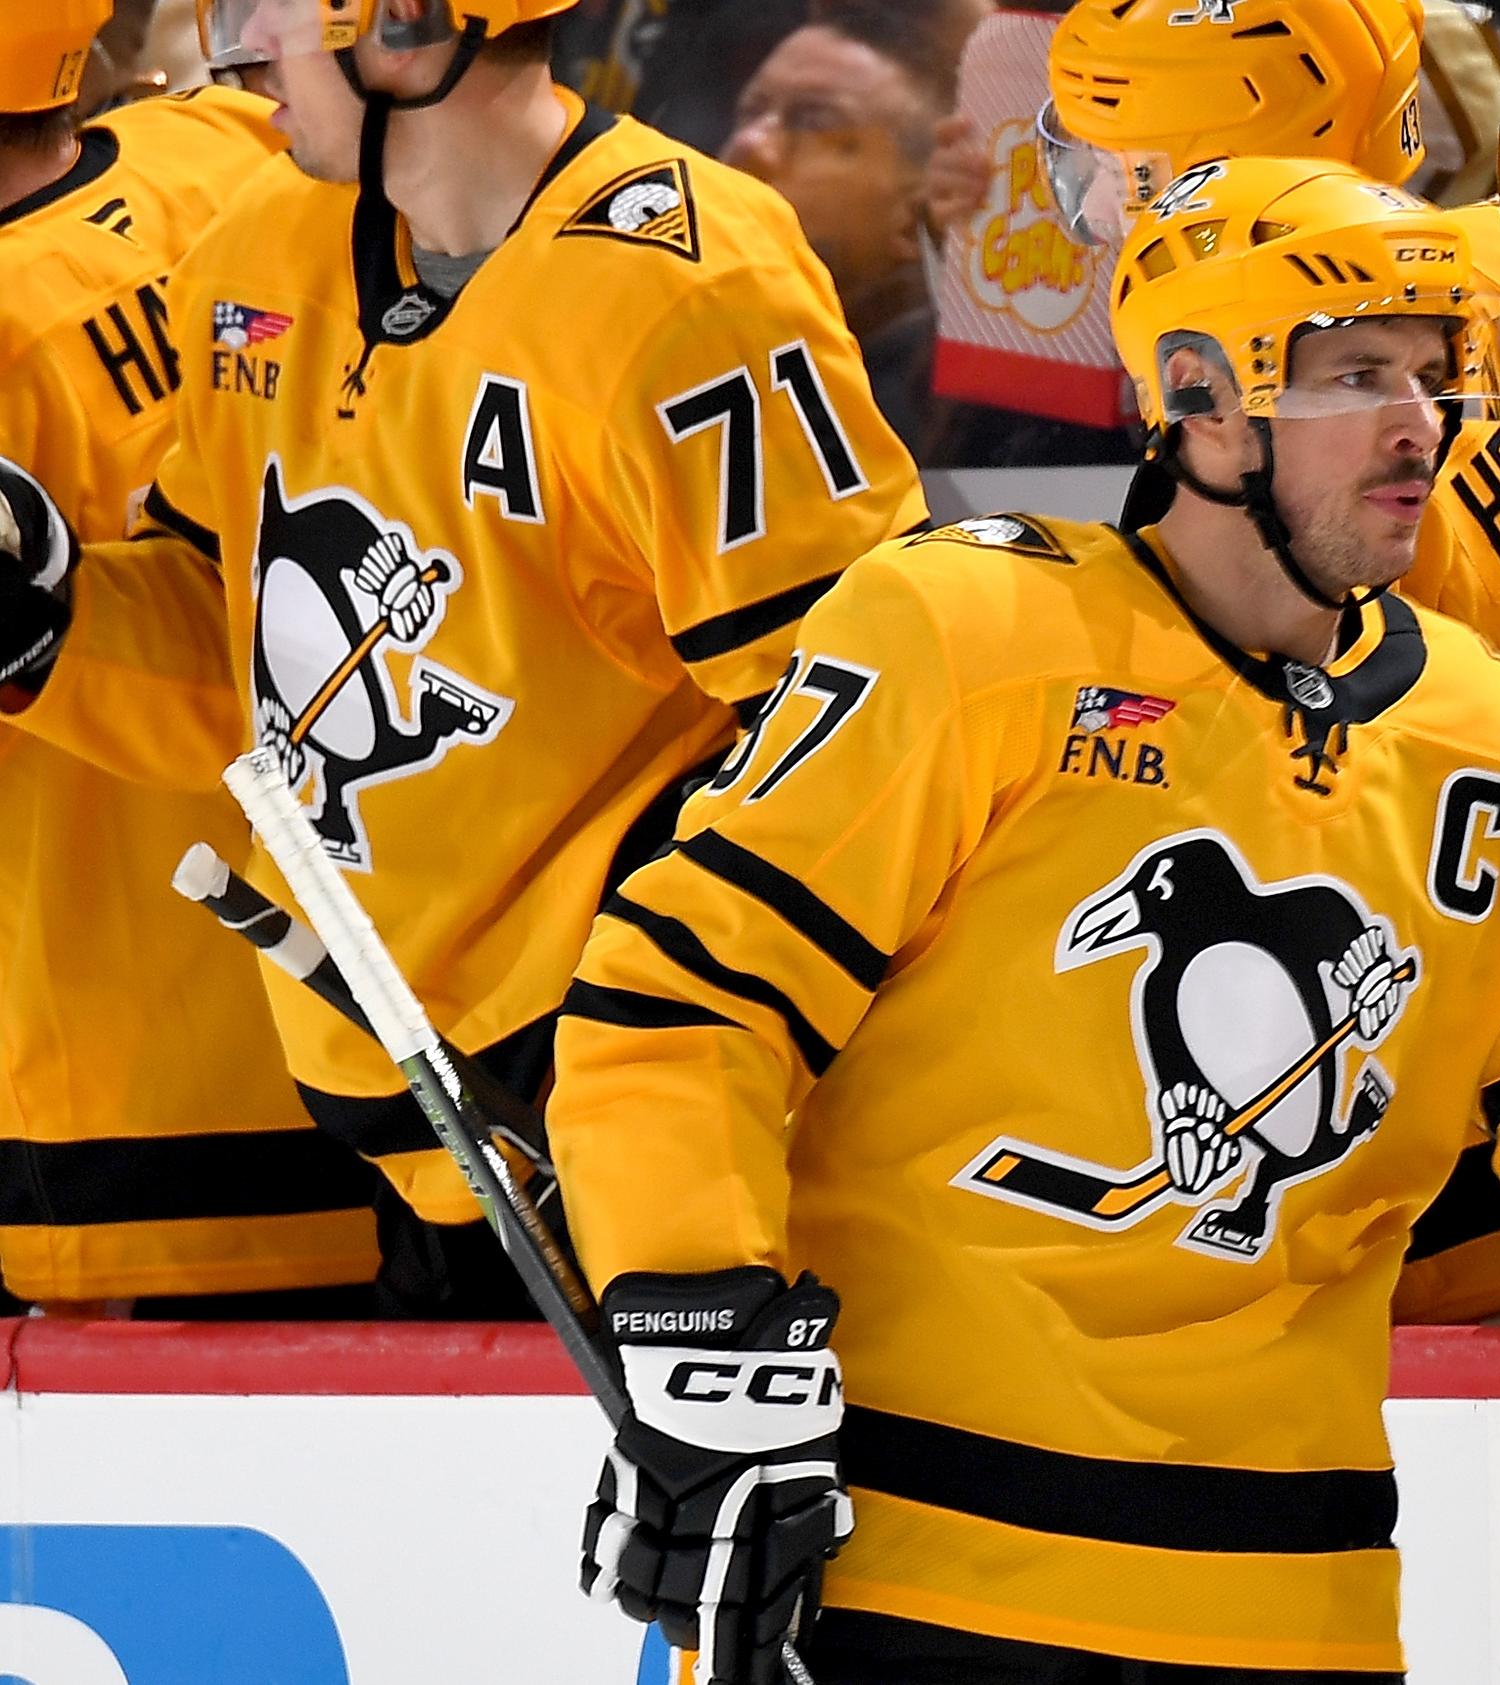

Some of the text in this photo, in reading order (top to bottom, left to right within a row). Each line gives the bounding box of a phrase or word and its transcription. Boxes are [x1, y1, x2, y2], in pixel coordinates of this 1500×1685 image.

[1401, 98, 1421, 158] 43
[1395, 247, 1455, 263] CCM
[82, 276, 182, 416] HA
[463, 372, 546, 524] A
[656, 337, 870, 555] 71
[1058, 735, 1171, 790] F.N.B.
[612, 1309, 736, 1333] PENGUINS
[787, 1318, 828, 1347] 87
